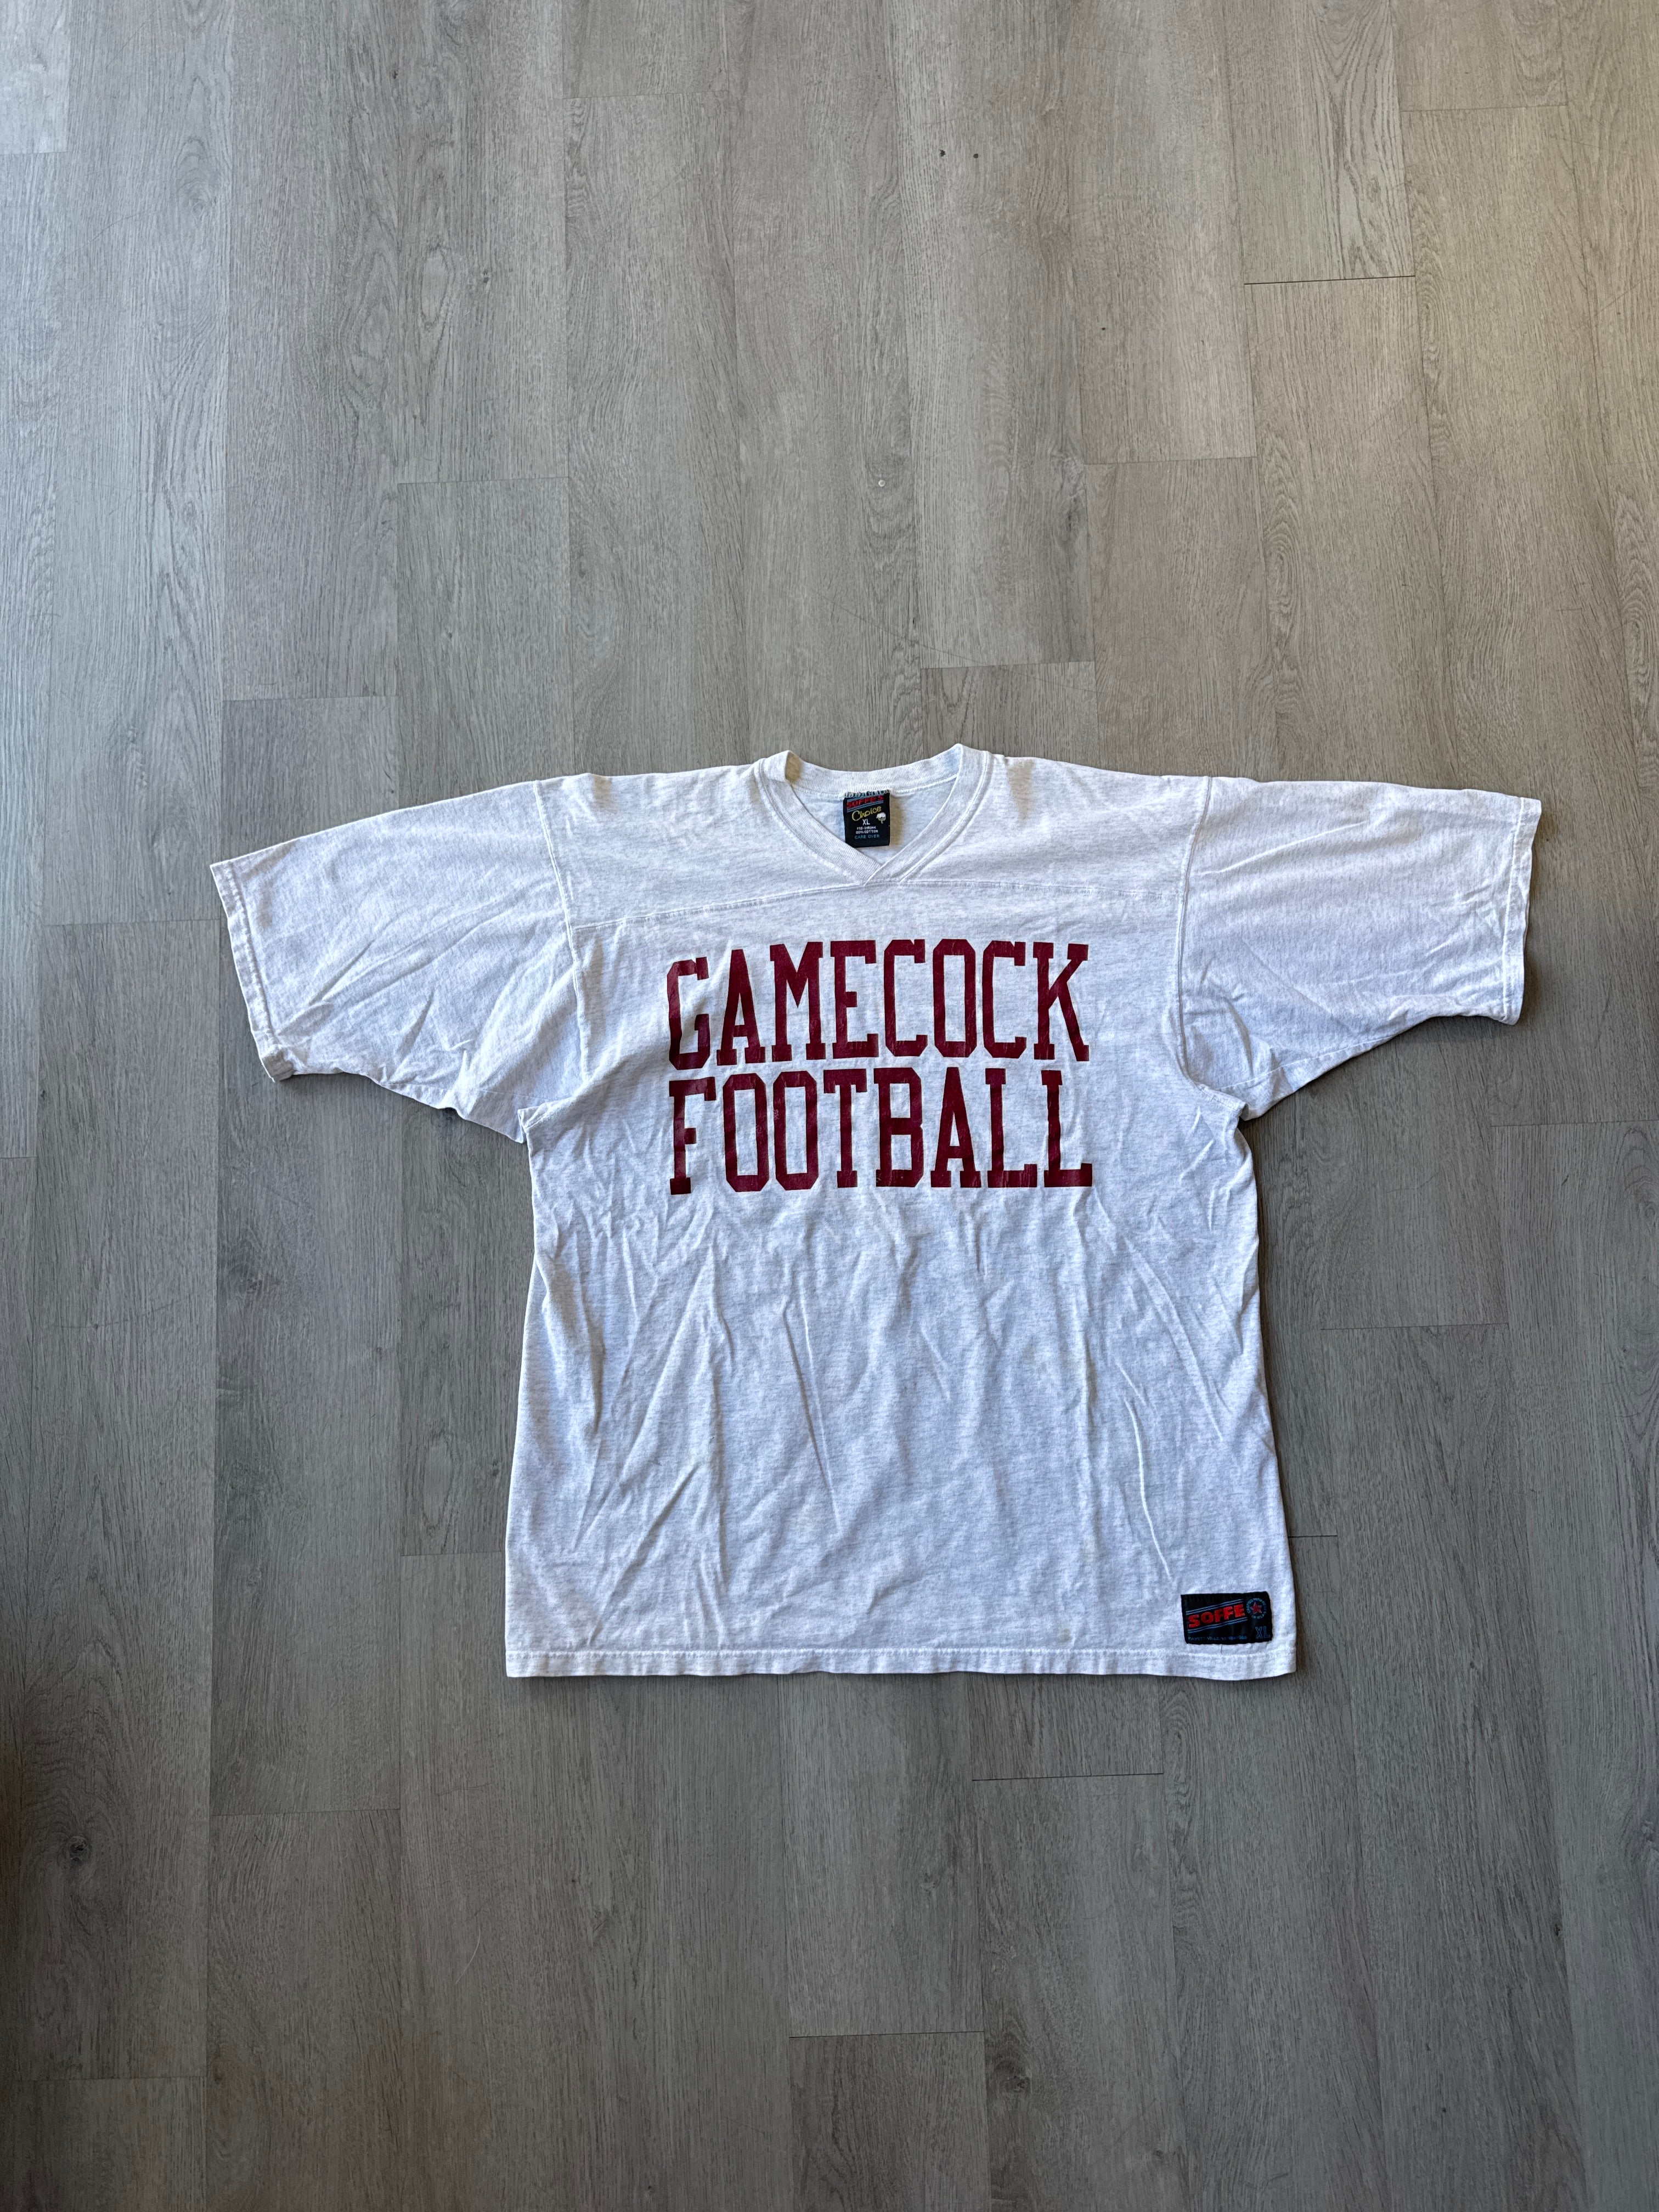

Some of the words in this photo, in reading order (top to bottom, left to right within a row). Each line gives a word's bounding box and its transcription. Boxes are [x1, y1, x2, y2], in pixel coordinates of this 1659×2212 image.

[852, 806, 882, 821] Choice
[667, 939, 1089, 1070] GAMECOCK
[669, 1066, 1092, 1194] FOOTBALL
[1188, 1604, 1245, 1628] SOFFE
[1255, 1626, 1271, 1639] XL
